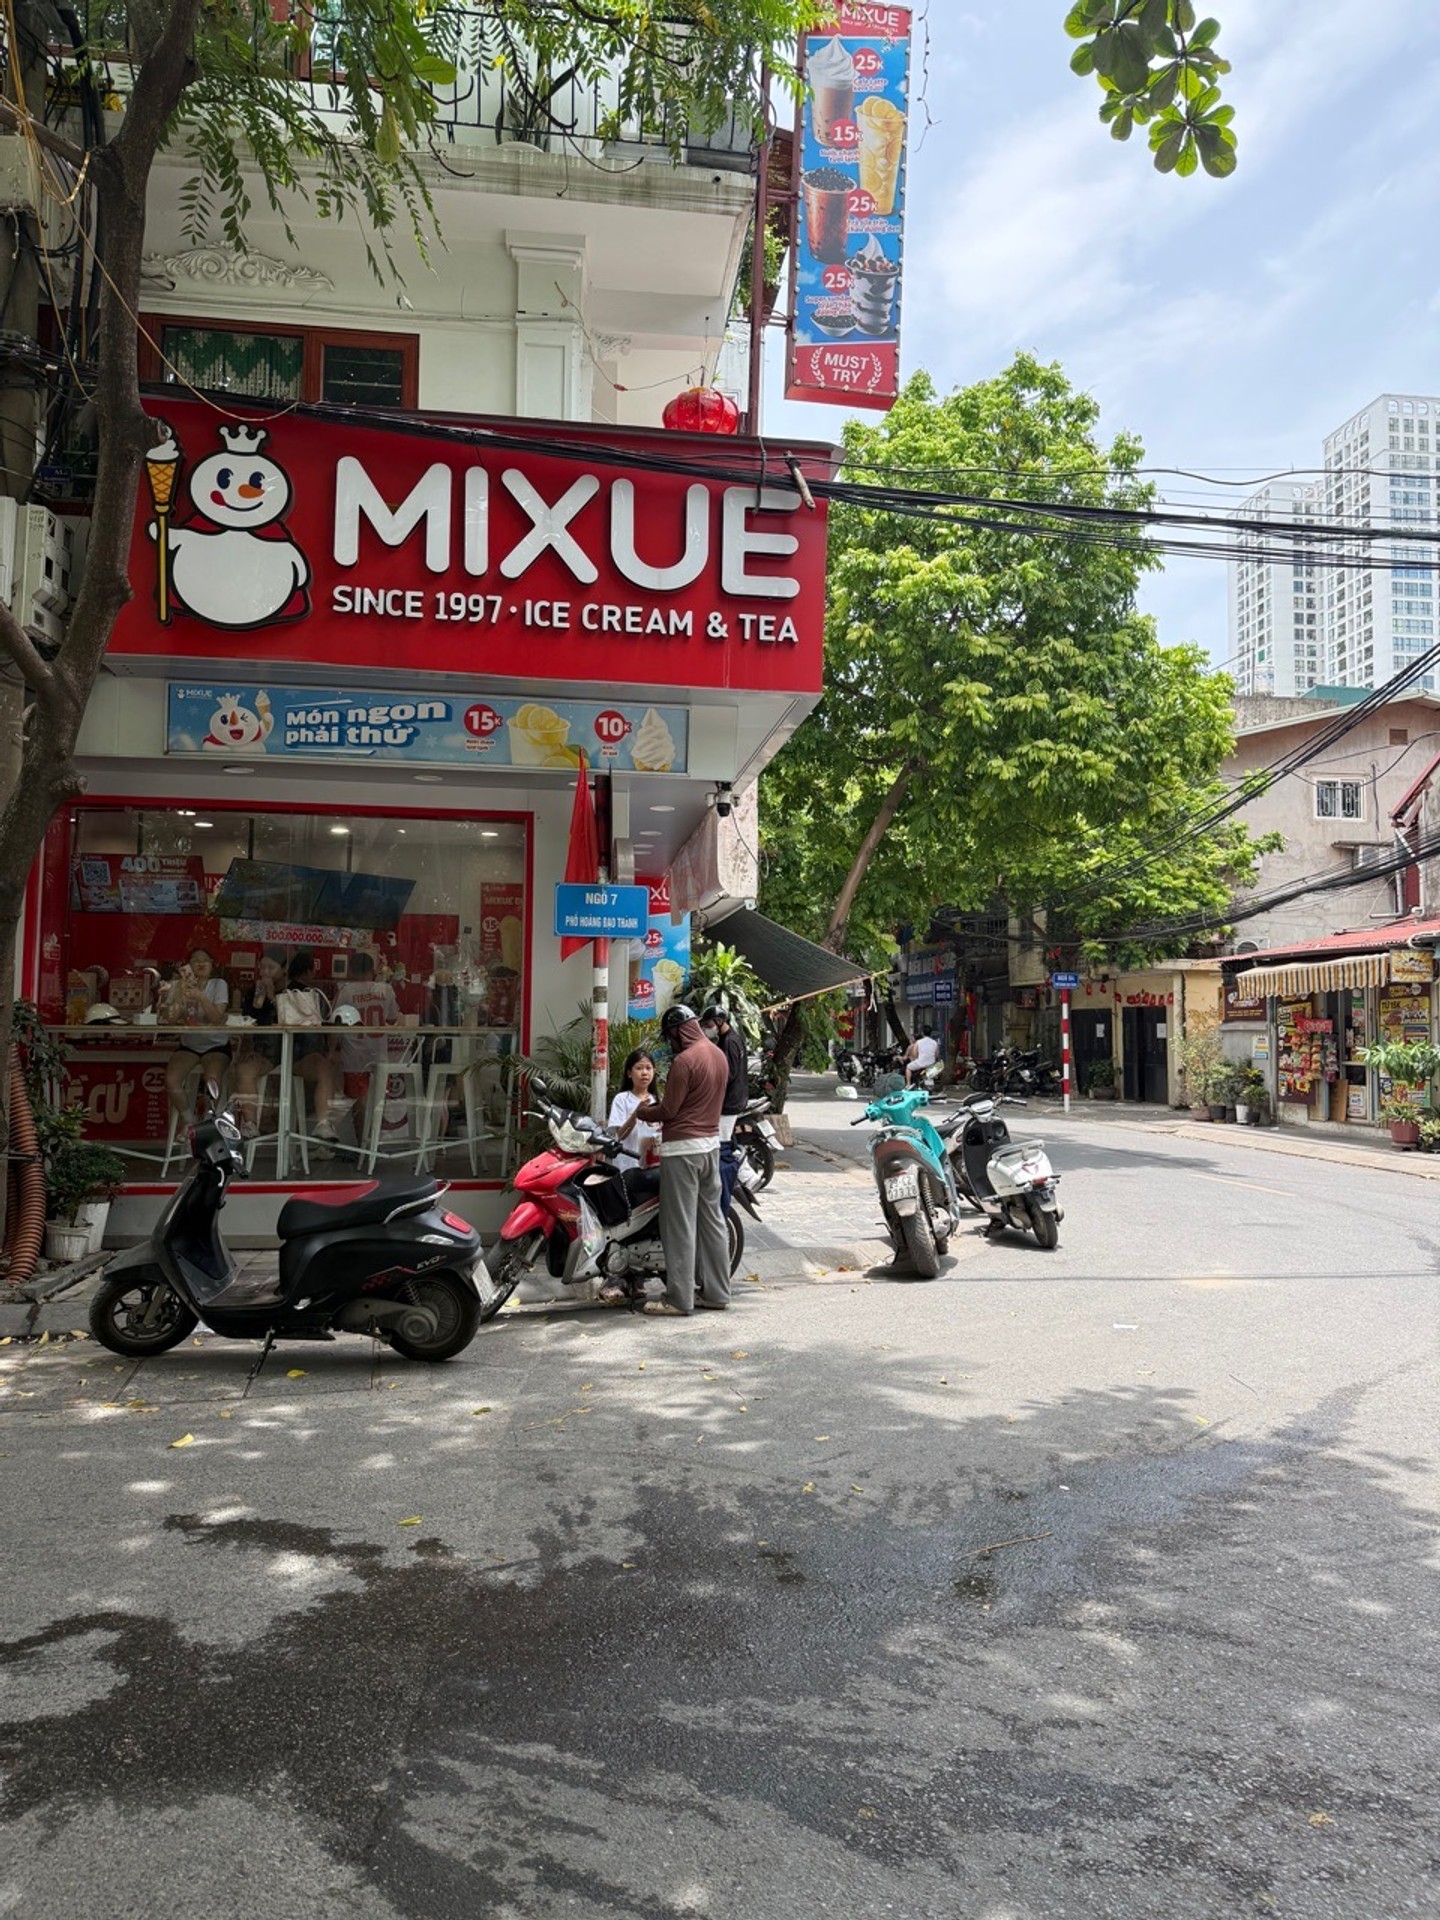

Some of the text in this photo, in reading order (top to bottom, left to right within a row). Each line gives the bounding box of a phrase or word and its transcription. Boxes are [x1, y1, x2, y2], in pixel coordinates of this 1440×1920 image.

[841, 4, 900, 27] MIXUE
[824, 353, 869, 370] MUST
[832, 368, 861, 384] TRY
[333, 456, 800, 598] MIXUE
[332, 585, 799, 643] SINCE 1997 ICE CREAM & TEA
[286, 701, 447, 726] Món ngon
[286, 722, 414, 746] phải thử
[610, 893, 618, 906] 7
